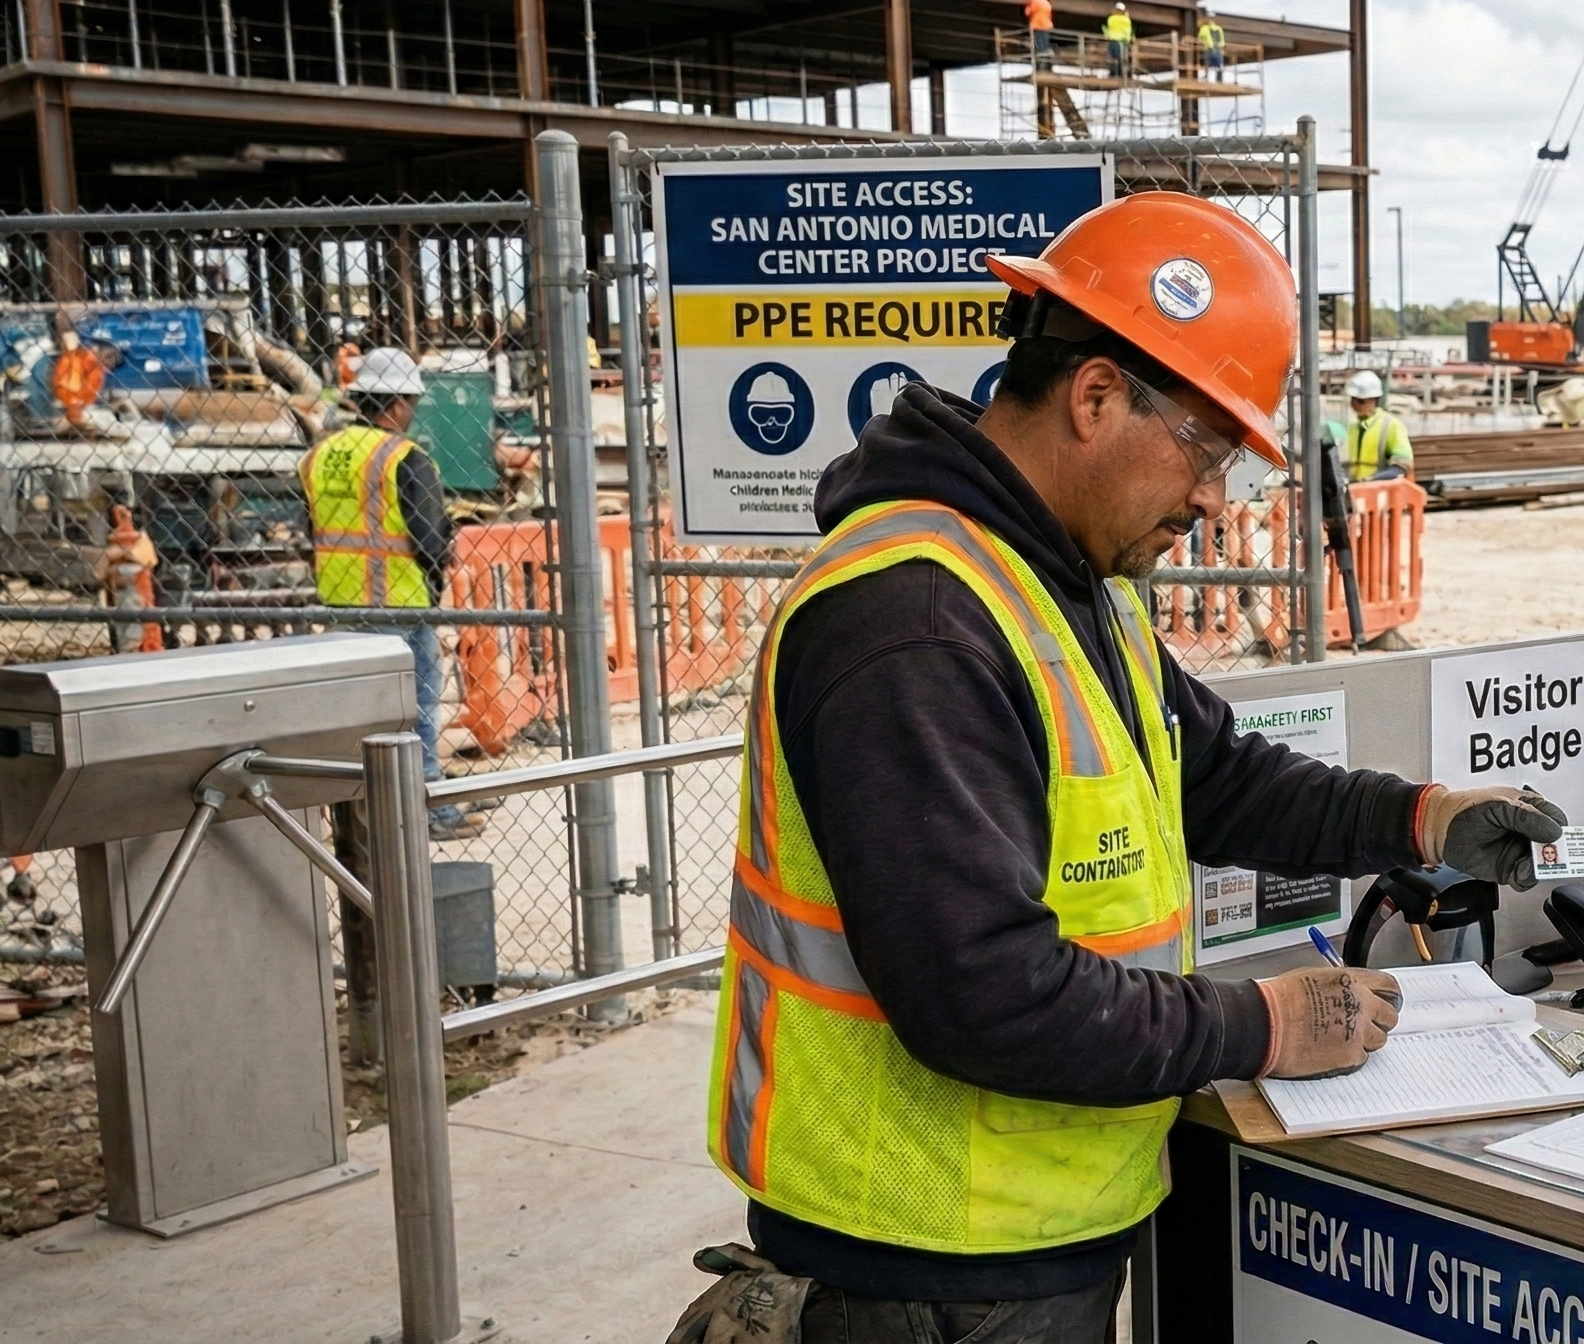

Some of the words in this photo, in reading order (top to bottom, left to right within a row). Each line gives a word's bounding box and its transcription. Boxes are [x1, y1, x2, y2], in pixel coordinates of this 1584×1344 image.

[787, 182, 847, 208] SITE
[855, 180, 973, 207] ACCESS:
[711, 217, 769, 242] SAN
[777, 215, 913, 241] ANTONIO
[921, 213, 1055, 239] MEDICAL
[758, 249, 870, 275] CENTER
[734, 302, 813, 338] PPE
[825, 301, 1006, 342] REQUIRE
[730, 484, 779, 496] Children
[1465, 673, 1583, 719] Visitor
[1301, 706, 1334, 723] FIRST
[1470, 724, 1582, 773] Badge
[1098, 826, 1130, 854] SITE
[1249, 1192, 1395, 1297] CHECK-IN
[1405, 1243, 1418, 1305] /
[1428, 1250, 1502, 1334] SITE
